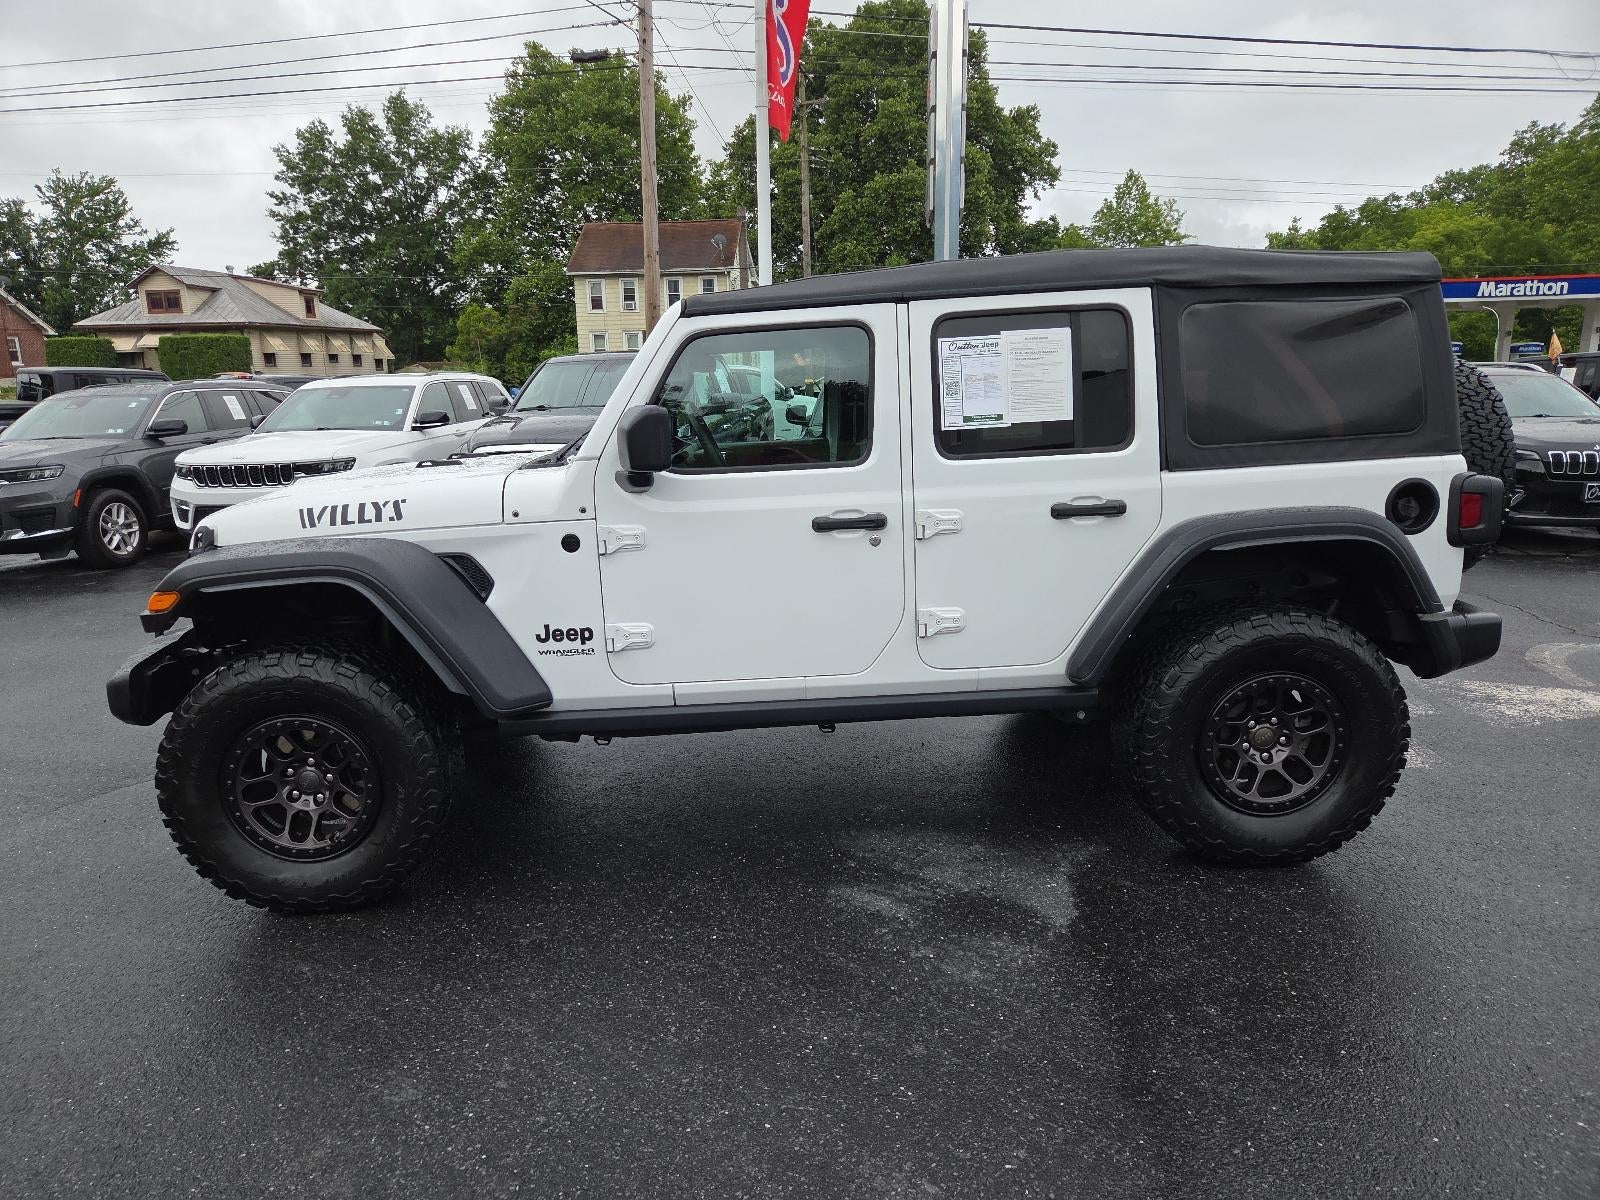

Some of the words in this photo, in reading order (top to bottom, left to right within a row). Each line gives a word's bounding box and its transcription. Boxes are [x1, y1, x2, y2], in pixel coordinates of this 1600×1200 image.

[1477, 280, 1568, 297] Marathon
[981, 341, 999, 349] Jeep
[299, 499, 407, 529] WILLYS
[535, 624, 594, 645] Jeep
[538, 647, 595, 656] WRANGLER
